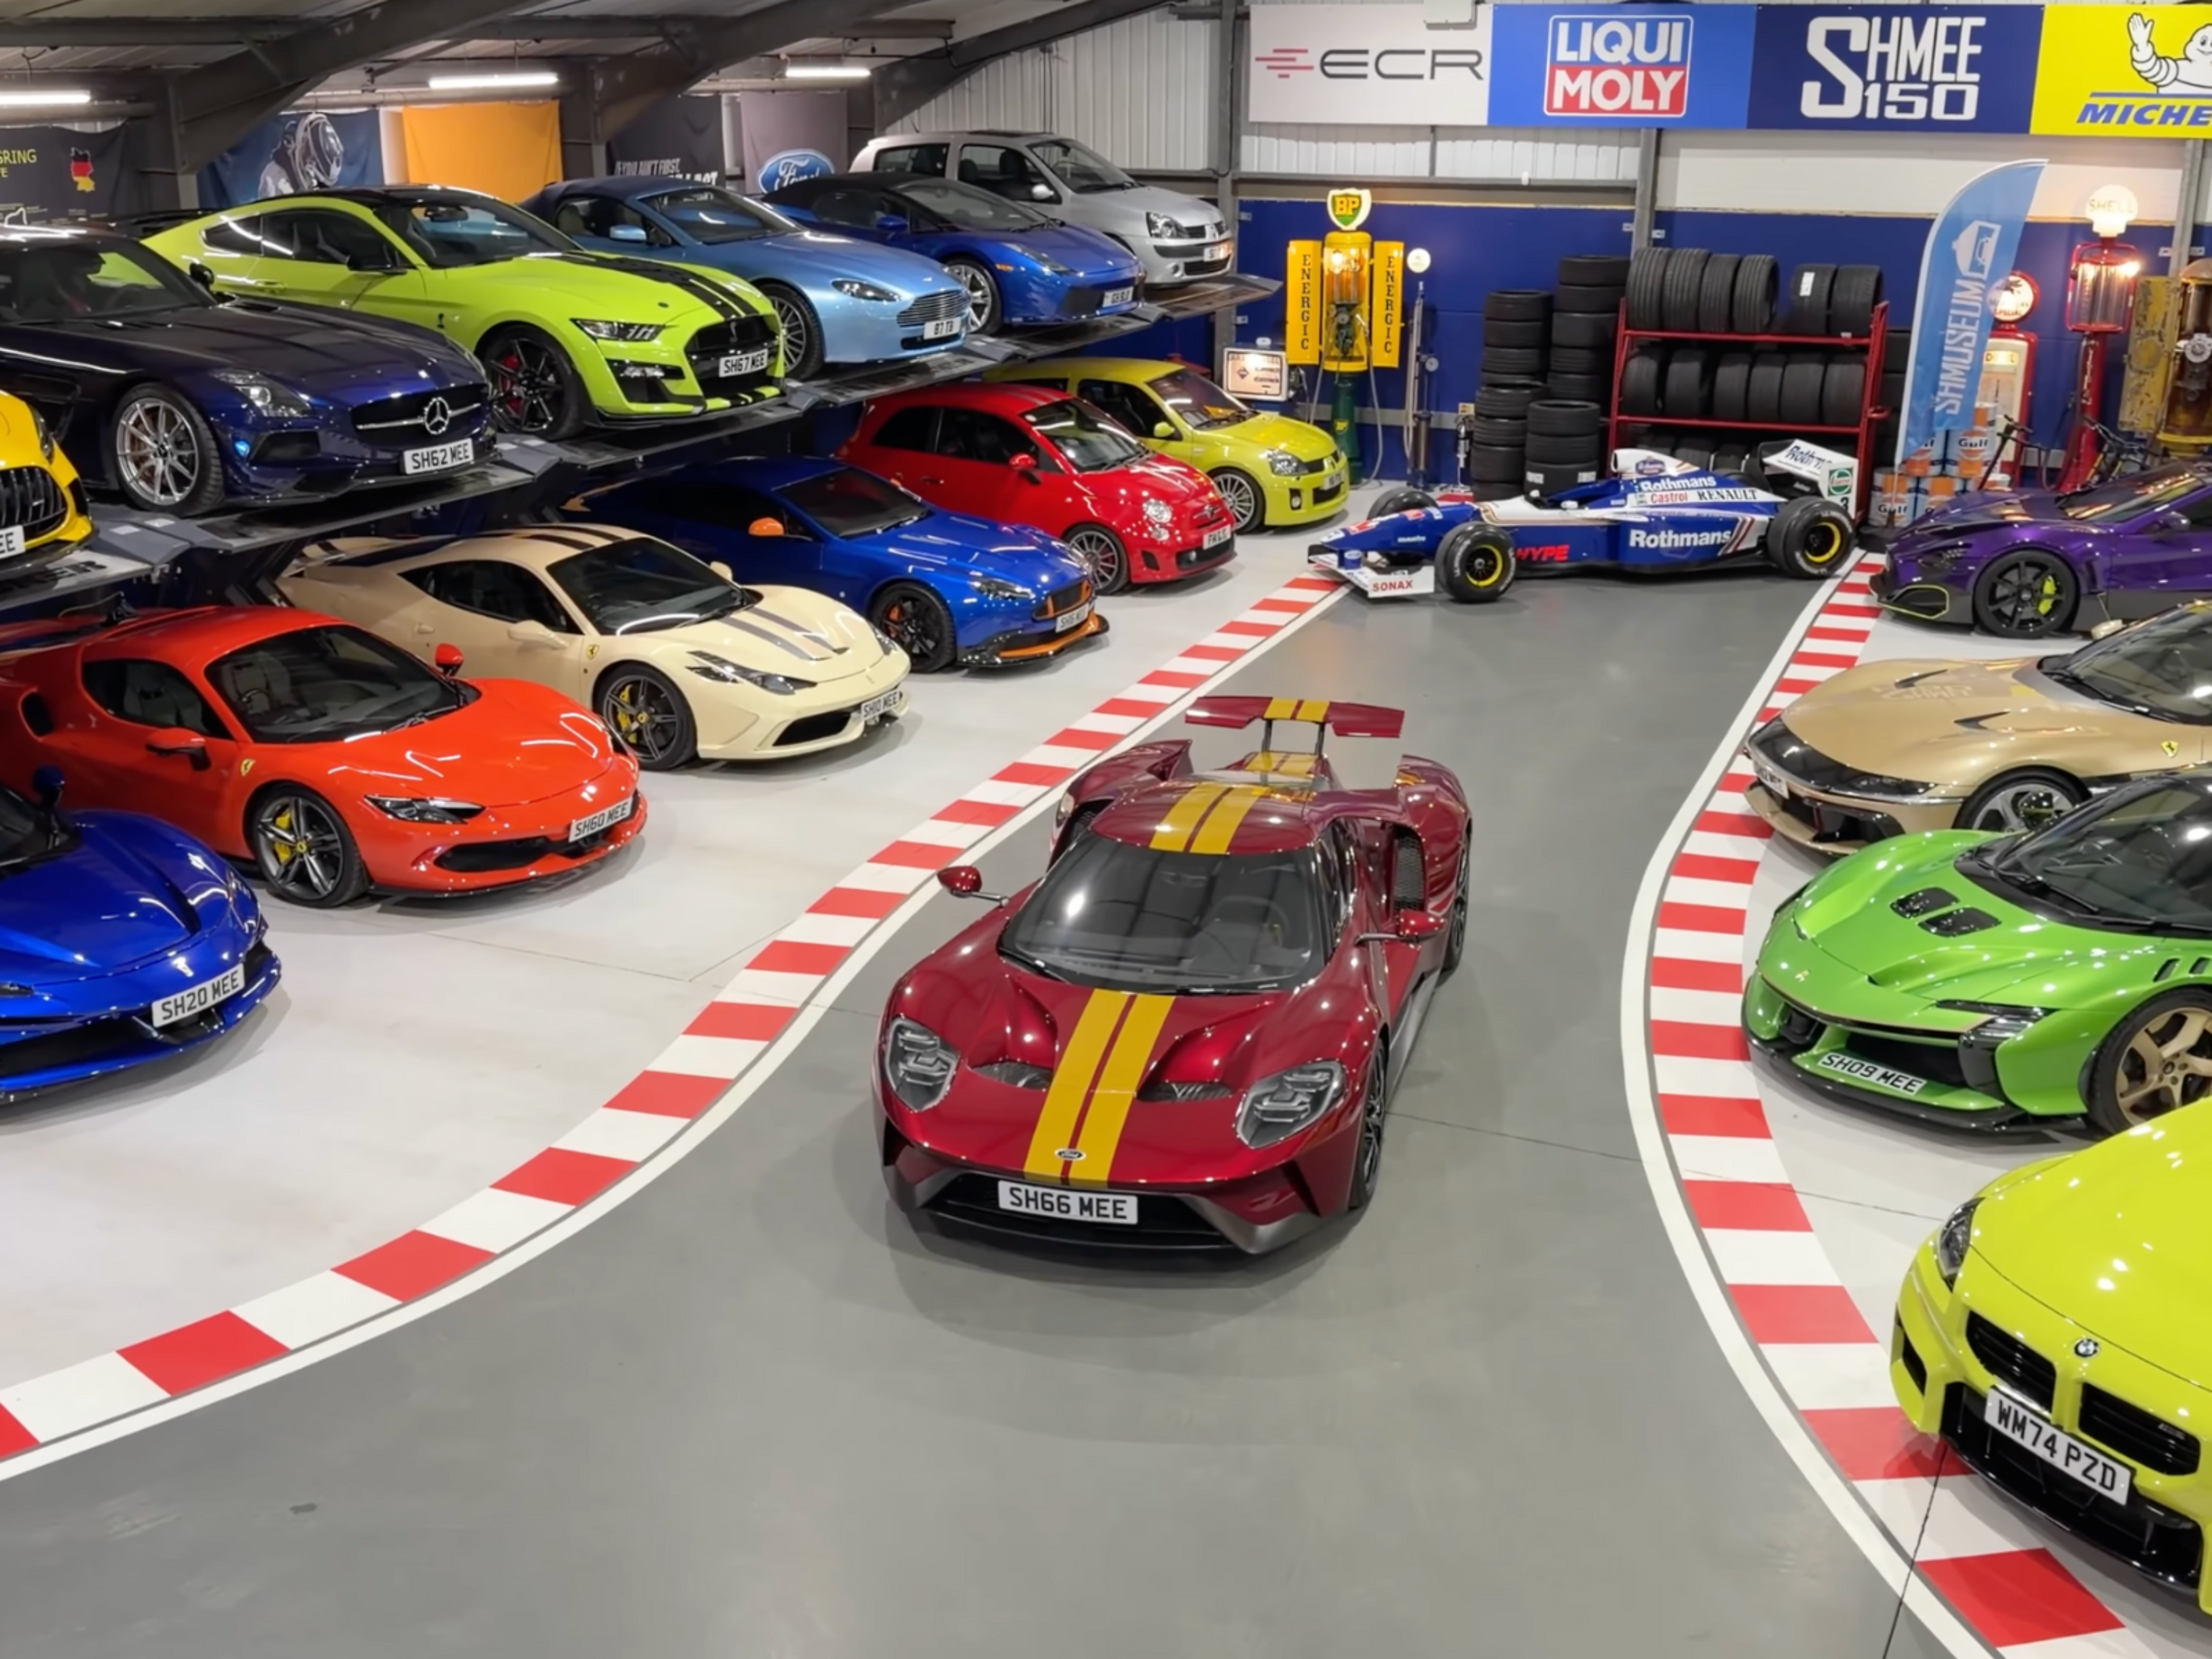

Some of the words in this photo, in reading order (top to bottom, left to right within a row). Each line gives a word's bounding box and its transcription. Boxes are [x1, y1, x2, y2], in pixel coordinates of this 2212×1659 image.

[1556, 21, 1684, 65] LIQUI
[1320, 49, 1484, 80] ECR
[1801, 17, 1986, 118] SHMEE
[1552, 69, 1685, 111] MOLY
[1863, 82, 1979, 120] 150
[1335, 196, 1360, 216] BP
[2089, 198, 2134, 214] SHELL
[1300, 253, 1312, 350] ENERGIC
[1384, 256, 1396, 354] ENERGIC
[1934, 279, 1987, 415] SHMUSEUM
[724, 356, 749, 374] SH67
[411, 449, 448, 470] SH62
[449, 442, 469, 463] MEE
[1959, 438, 1988, 448] Gulf
[1641, 476, 1717, 493] Rothmans
[1650, 491, 1688, 504] Castrol
[1697, 488, 1758, 501] RENAULT
[1516, 544, 1570, 562] HYPE
[1629, 529, 1732, 548] Rothmans
[1372, 580, 1414, 592] SONAX
[575, 812, 605, 838] SH60
[606, 801, 629, 824] MEE
[161, 987, 207, 1021] SH20
[211, 969, 240, 1001] MEE
[1821, 1054, 1878, 1078] SH09
[1876, 1070, 1923, 1093] MEE
[1009, 1187, 1071, 1214] SH66
[1079, 1195, 1127, 1219] MEE
[1998, 1399, 2058, 1459] WM74
[2064, 1442, 2116, 1491] PZD
